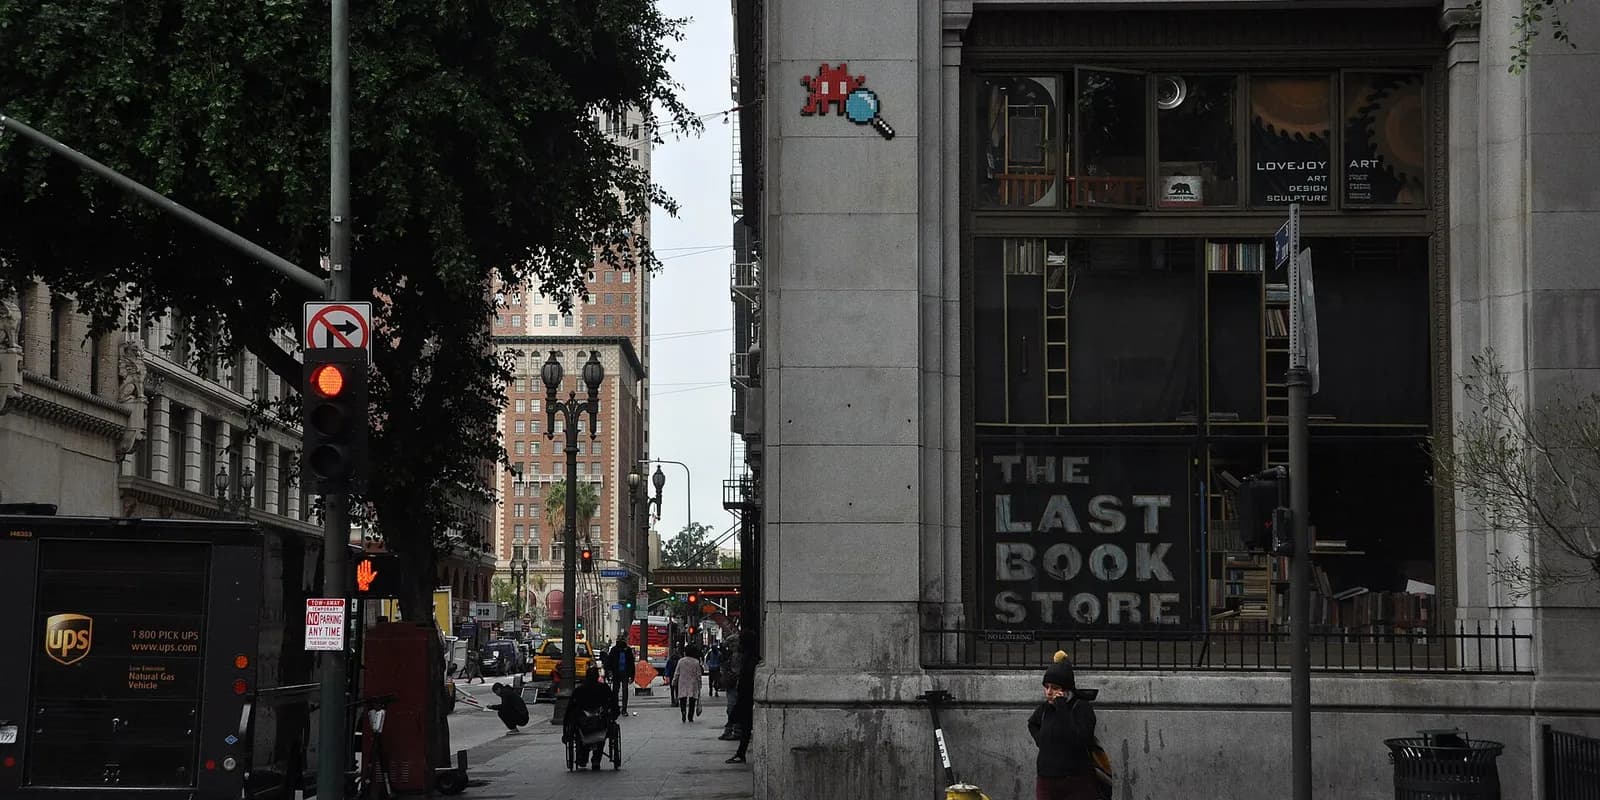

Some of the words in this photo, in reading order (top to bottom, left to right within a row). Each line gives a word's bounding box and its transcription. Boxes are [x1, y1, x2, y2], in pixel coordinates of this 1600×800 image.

[1256, 161, 1327, 171] LOVEJOY
[1349, 160, 1379, 168] ART
[993, 456, 1090, 484] THE
[995, 494, 1172, 535] LAST
[995, 542, 1175, 582] BOOK
[994, 591, 1180, 625] STORE
[308, 613, 319, 624] NO
[320, 614, 341, 624] PARKING
[138, 630, 156, 640] 800
[159, 630, 179, 640] PICK
[181, 631, 199, 640] UPS
[308, 627, 322, 636] ANY
[325, 627, 340, 636] TIME
[50, 629, 88, 657] ups
[131, 643, 197, 654] www.ups.com
[128, 672, 159, 681] Natural
[160, 672, 176, 681] Gas
[128, 681, 158, 689] Vehicle
